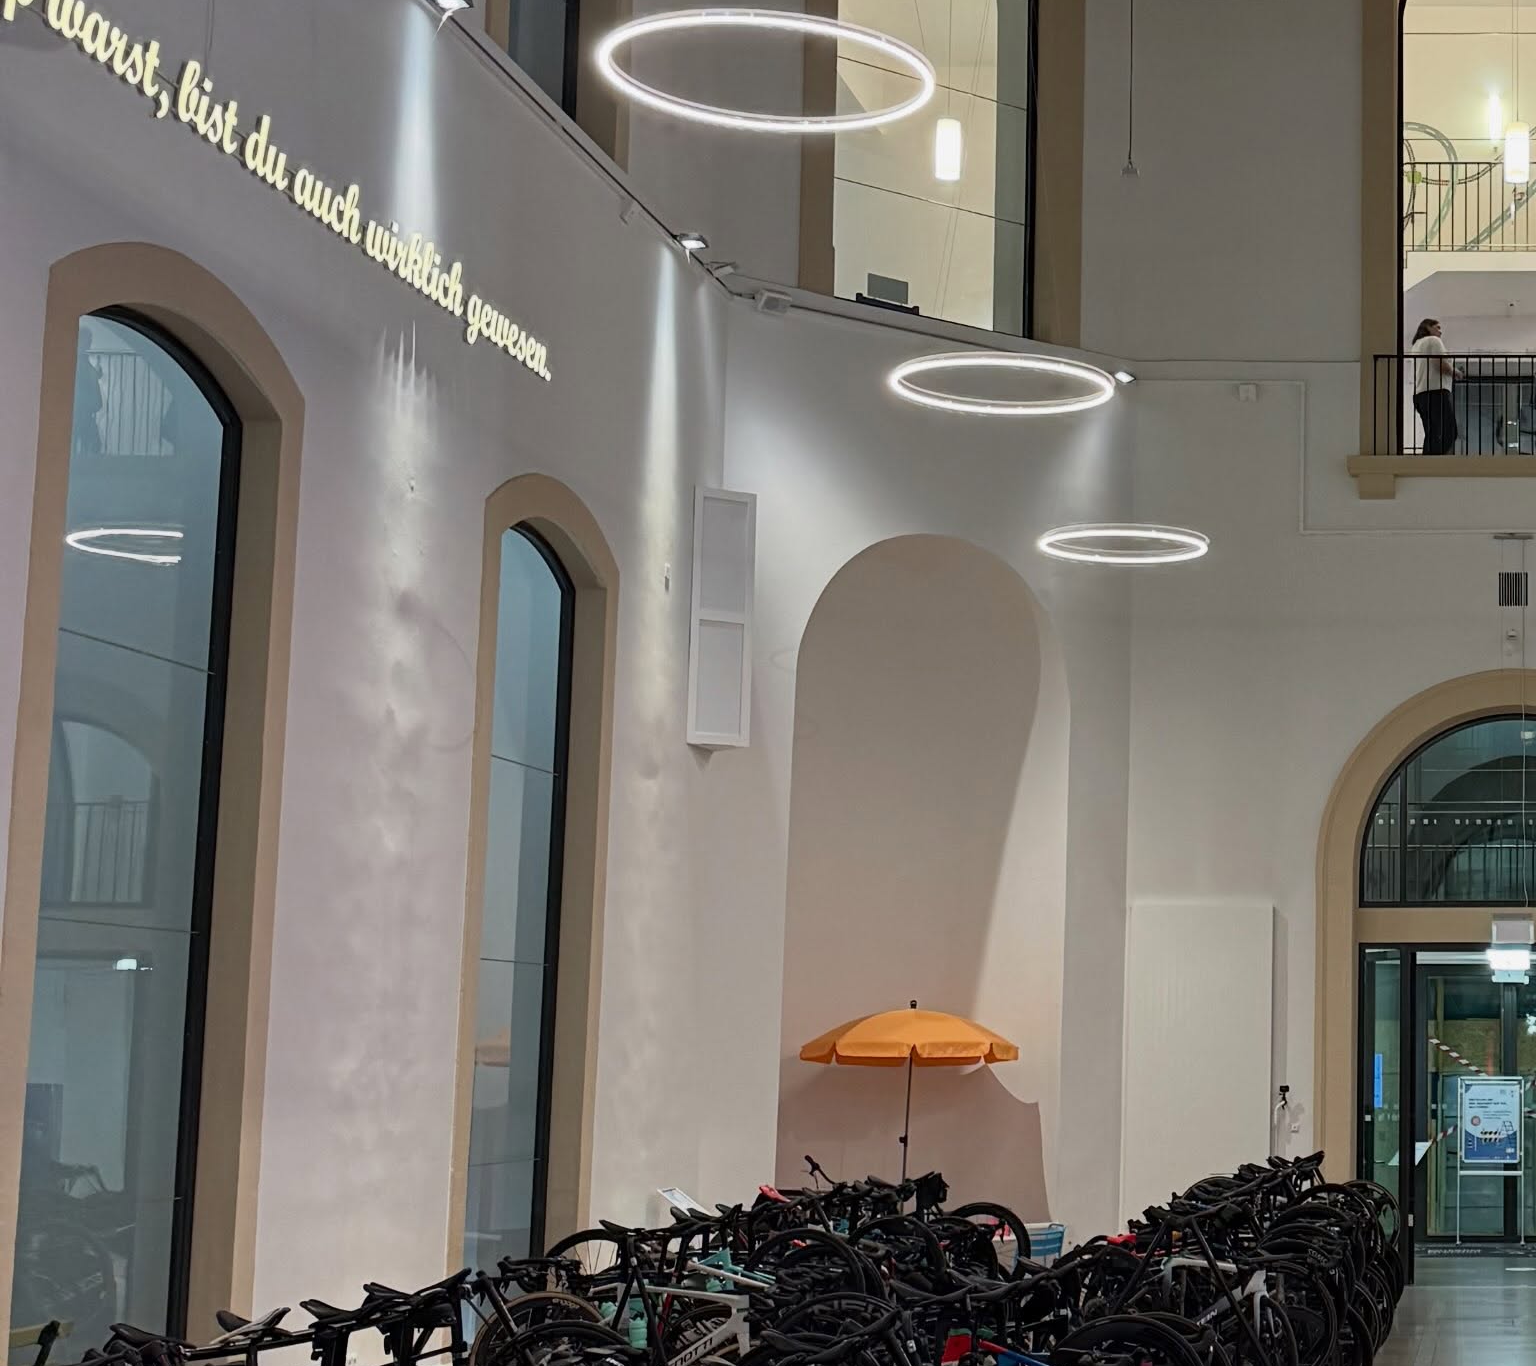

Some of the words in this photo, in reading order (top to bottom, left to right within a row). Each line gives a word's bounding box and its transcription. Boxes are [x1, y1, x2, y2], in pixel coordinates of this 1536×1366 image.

[177, 60, 238, 154] bist
[245, 114, 289, 191] du
[294, 168, 361, 244] auch
[366, 220, 464, 317] wirklich
[466, 294, 552, 381] gewesen.
